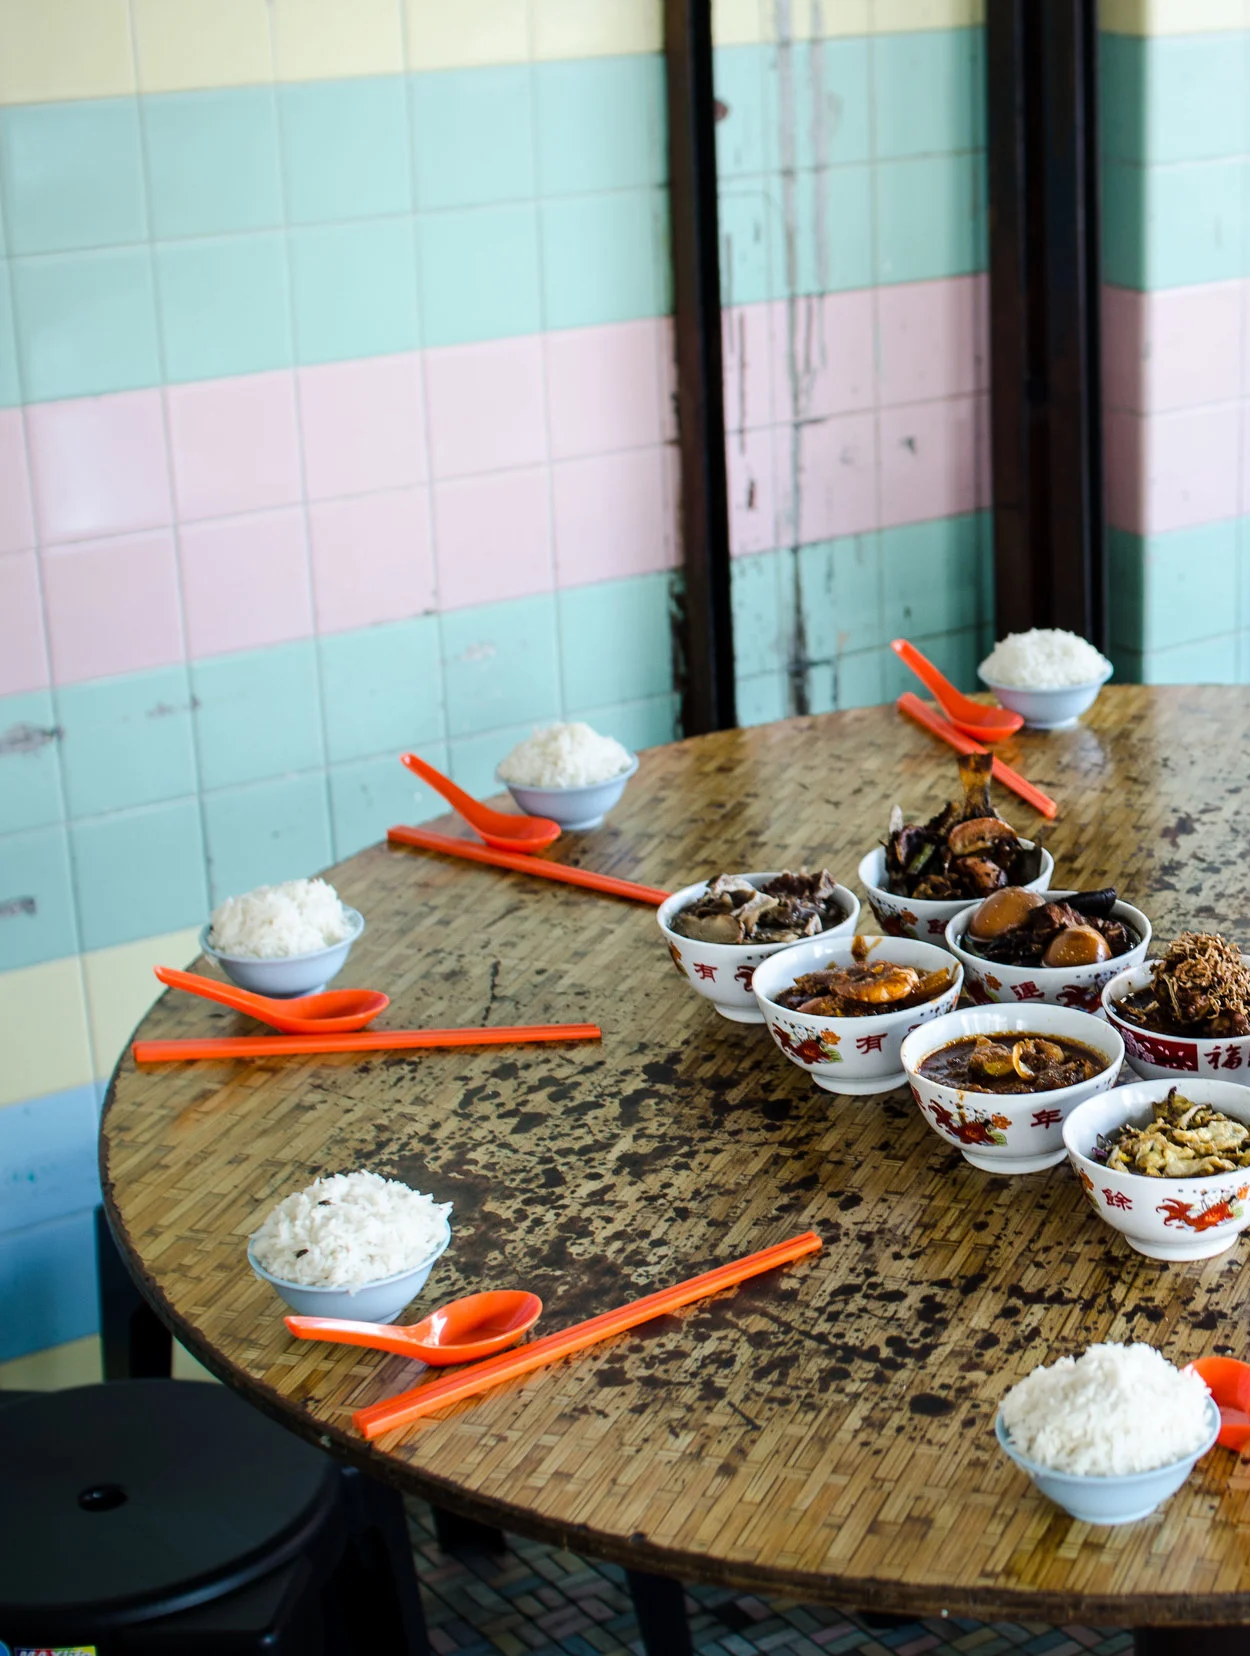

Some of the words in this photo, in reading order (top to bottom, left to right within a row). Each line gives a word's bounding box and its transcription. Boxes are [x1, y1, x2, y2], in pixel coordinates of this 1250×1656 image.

[693, 962, 718, 983] 有
[1010, 980, 1045, 1001] 連
[856, 1034, 888, 1055] 有
[1203, 1043, 1243, 1070] 福
[1030, 1109, 1064, 1130] 年
[1101, 1188, 1133, 1211] 餘
